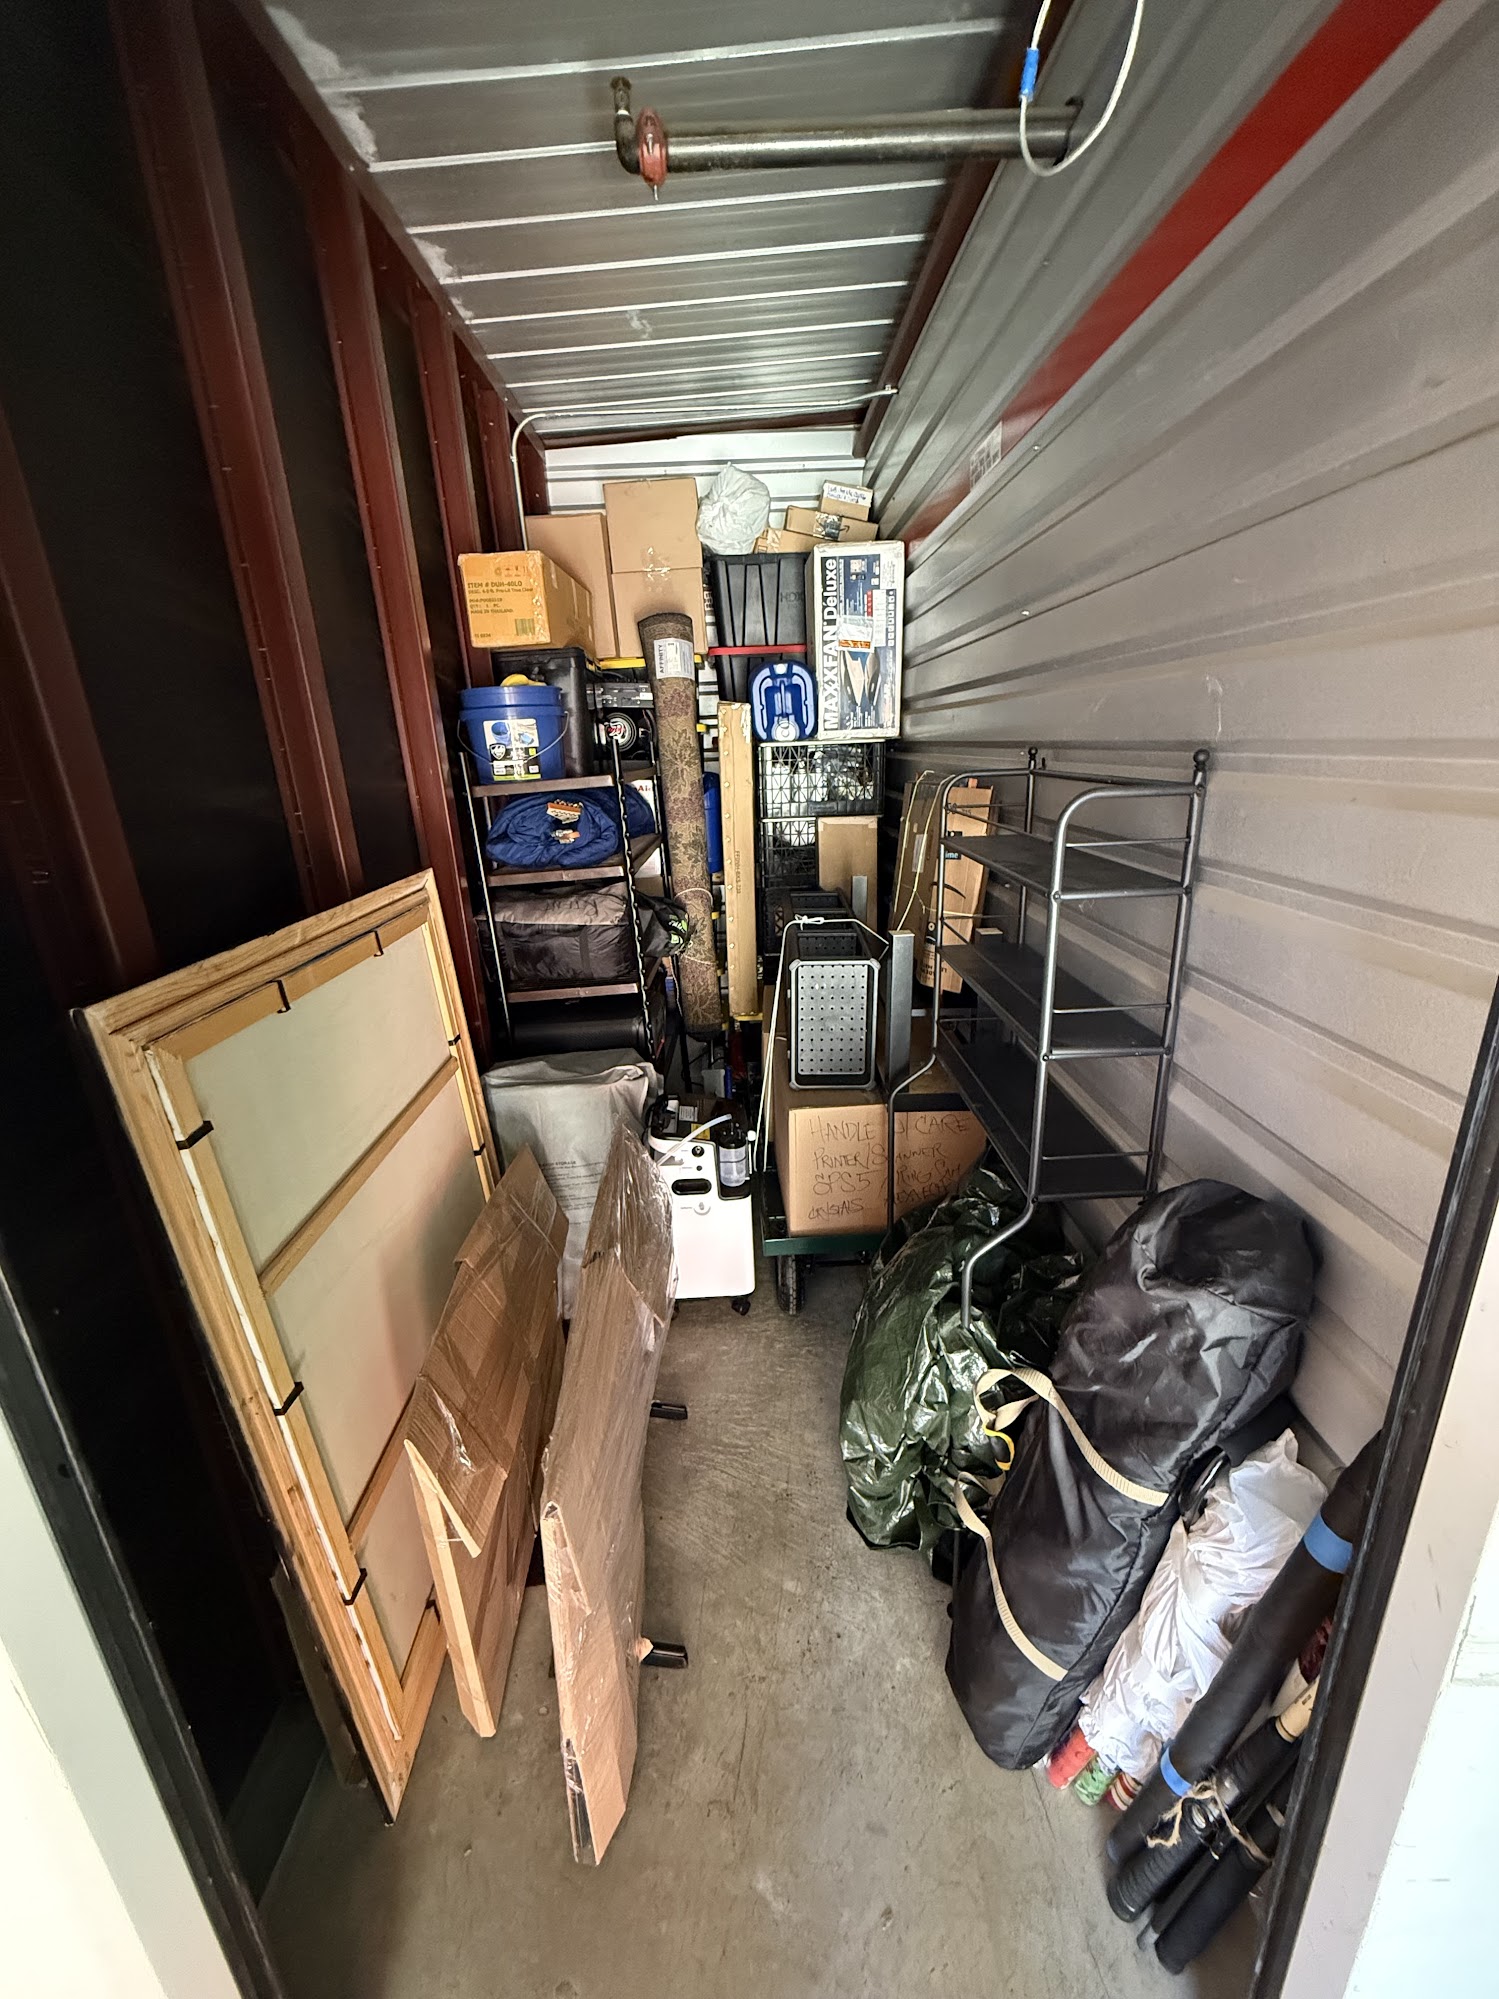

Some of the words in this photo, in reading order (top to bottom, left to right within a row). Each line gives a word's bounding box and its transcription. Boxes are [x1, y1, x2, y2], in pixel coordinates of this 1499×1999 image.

[657, 644, 665, 674] AFFINITY
[823, 627, 840, 730] MAXXFAN
[809, 1115, 876, 1143] HANDLE
[914, 1113, 970, 1135] CARE
